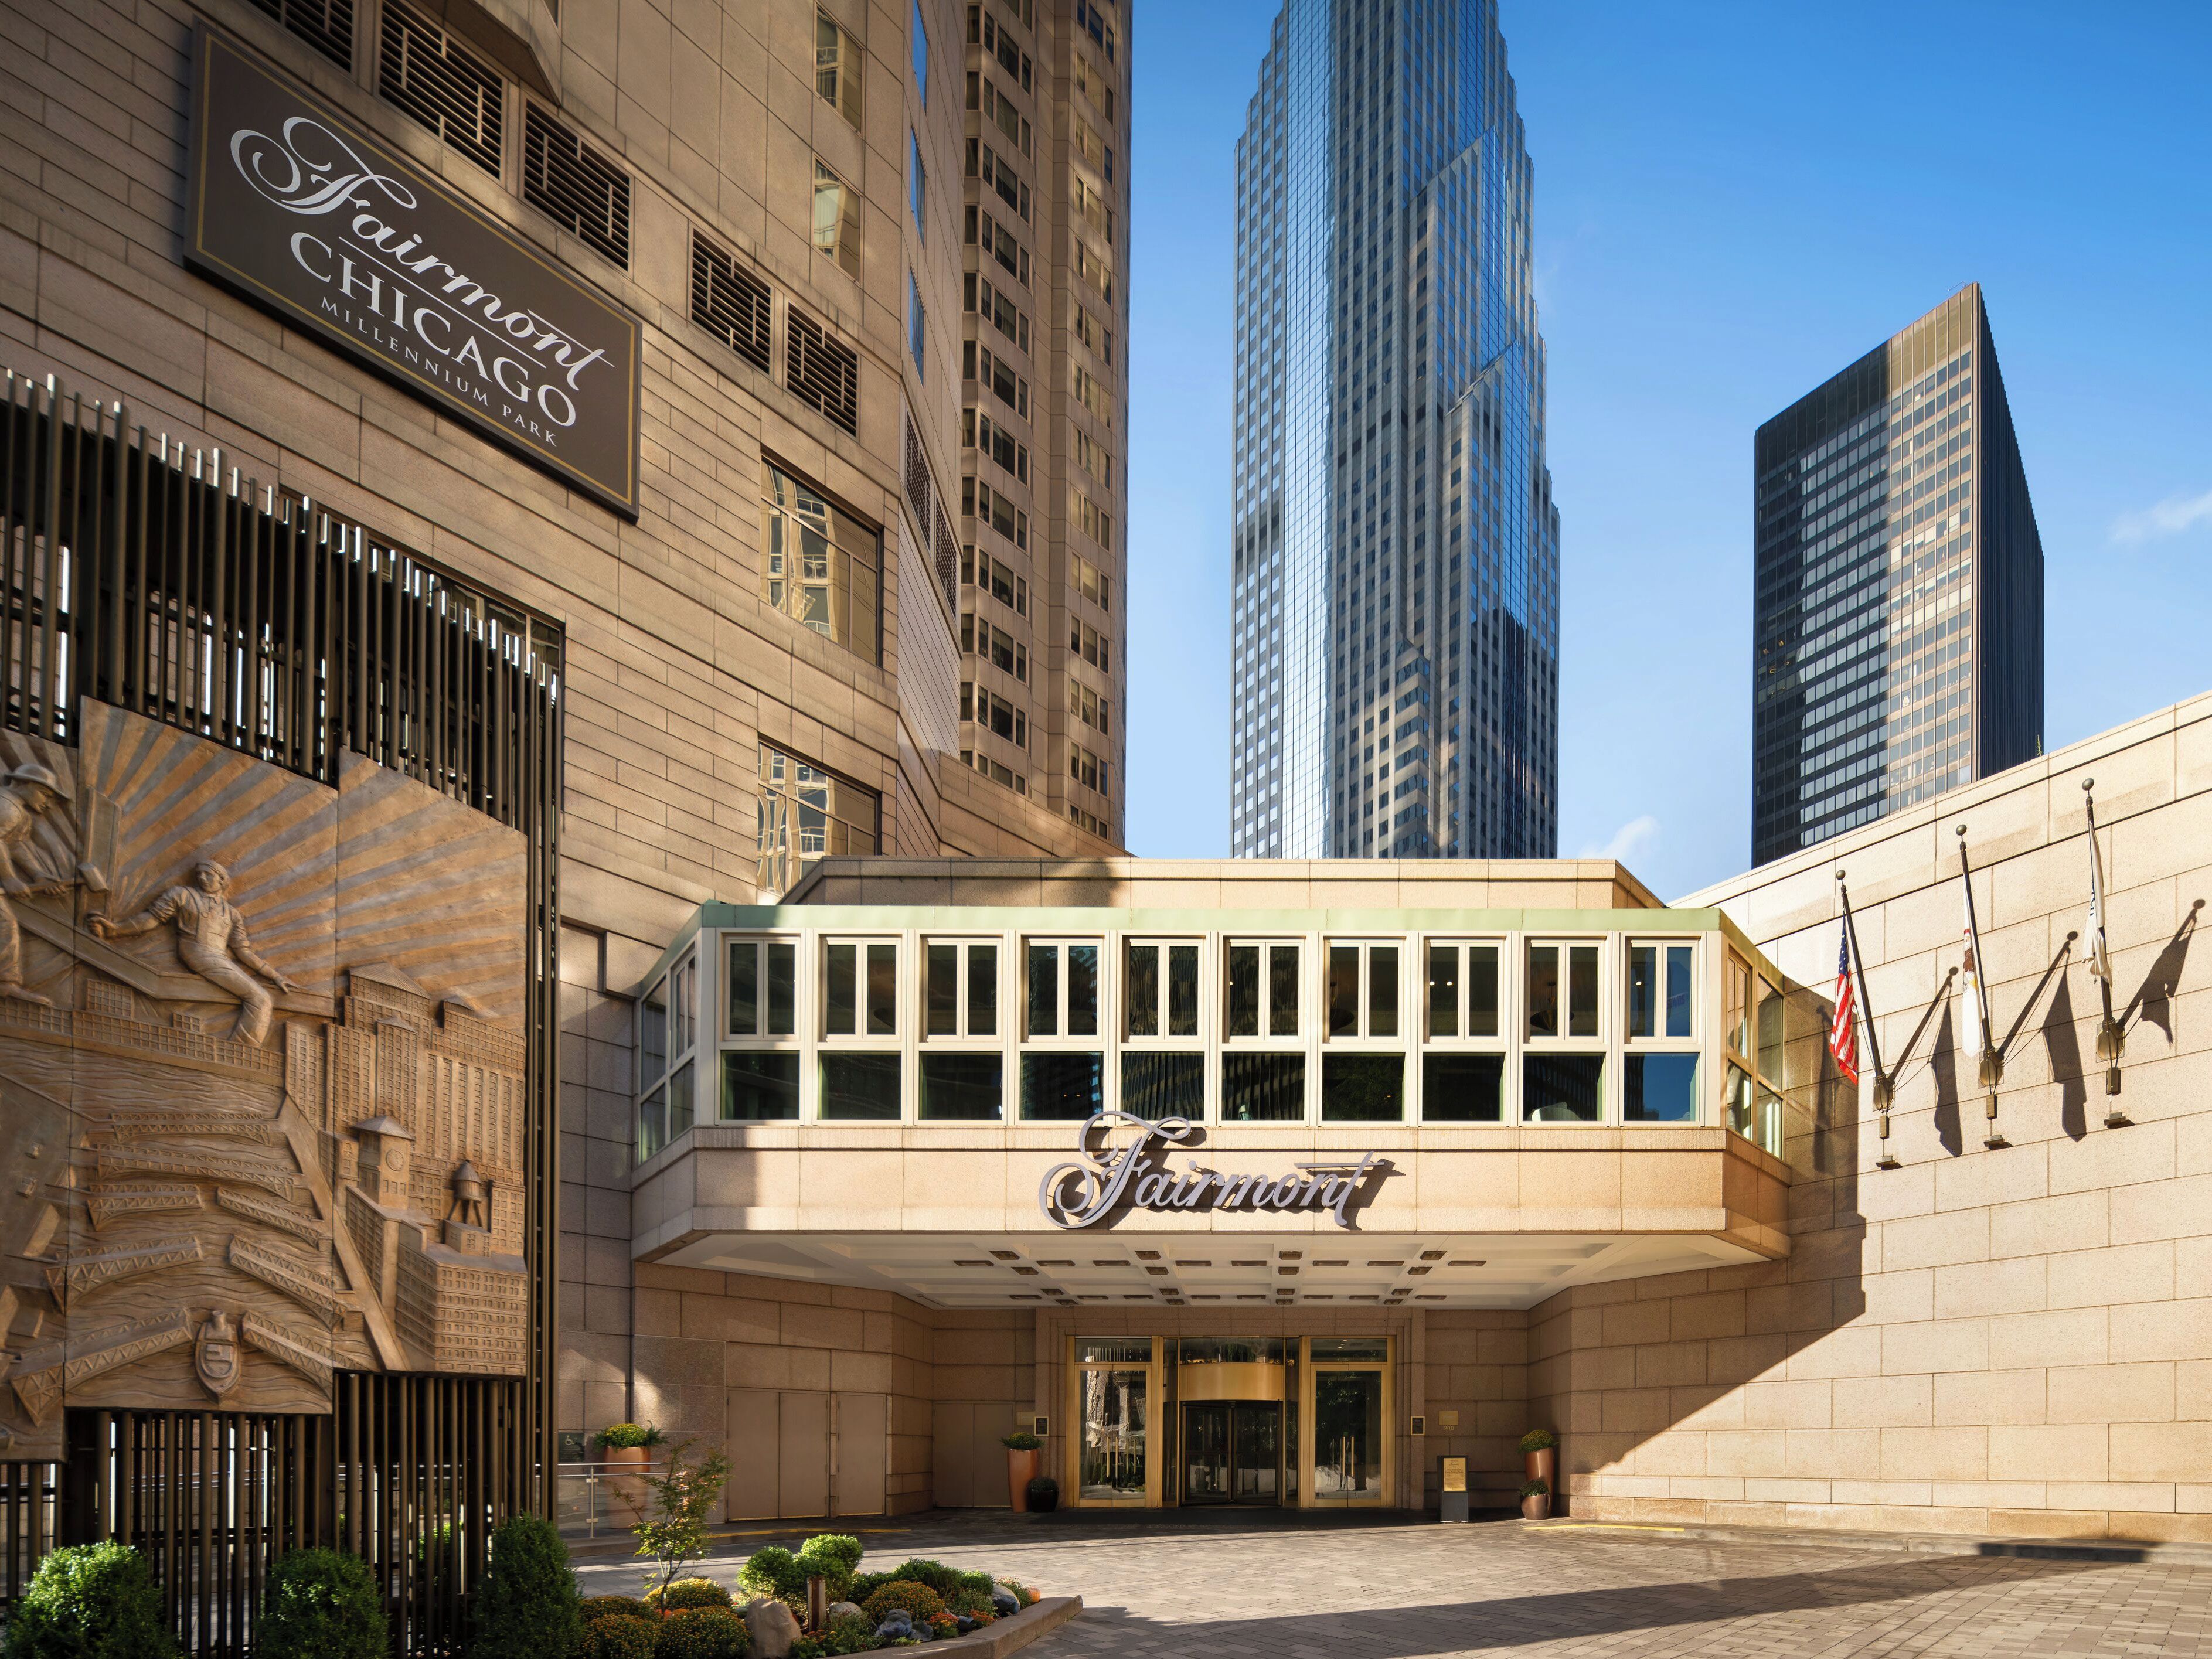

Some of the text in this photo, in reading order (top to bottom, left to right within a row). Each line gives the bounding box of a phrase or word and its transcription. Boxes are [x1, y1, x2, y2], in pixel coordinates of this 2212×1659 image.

[230, 117, 615, 390] Fairmont
[290, 231, 577, 427] CHICAGO
[321, 297, 557, 447] MILLENNIUM PARK
[1038, 1110, 1384, 1229] Fairmont
